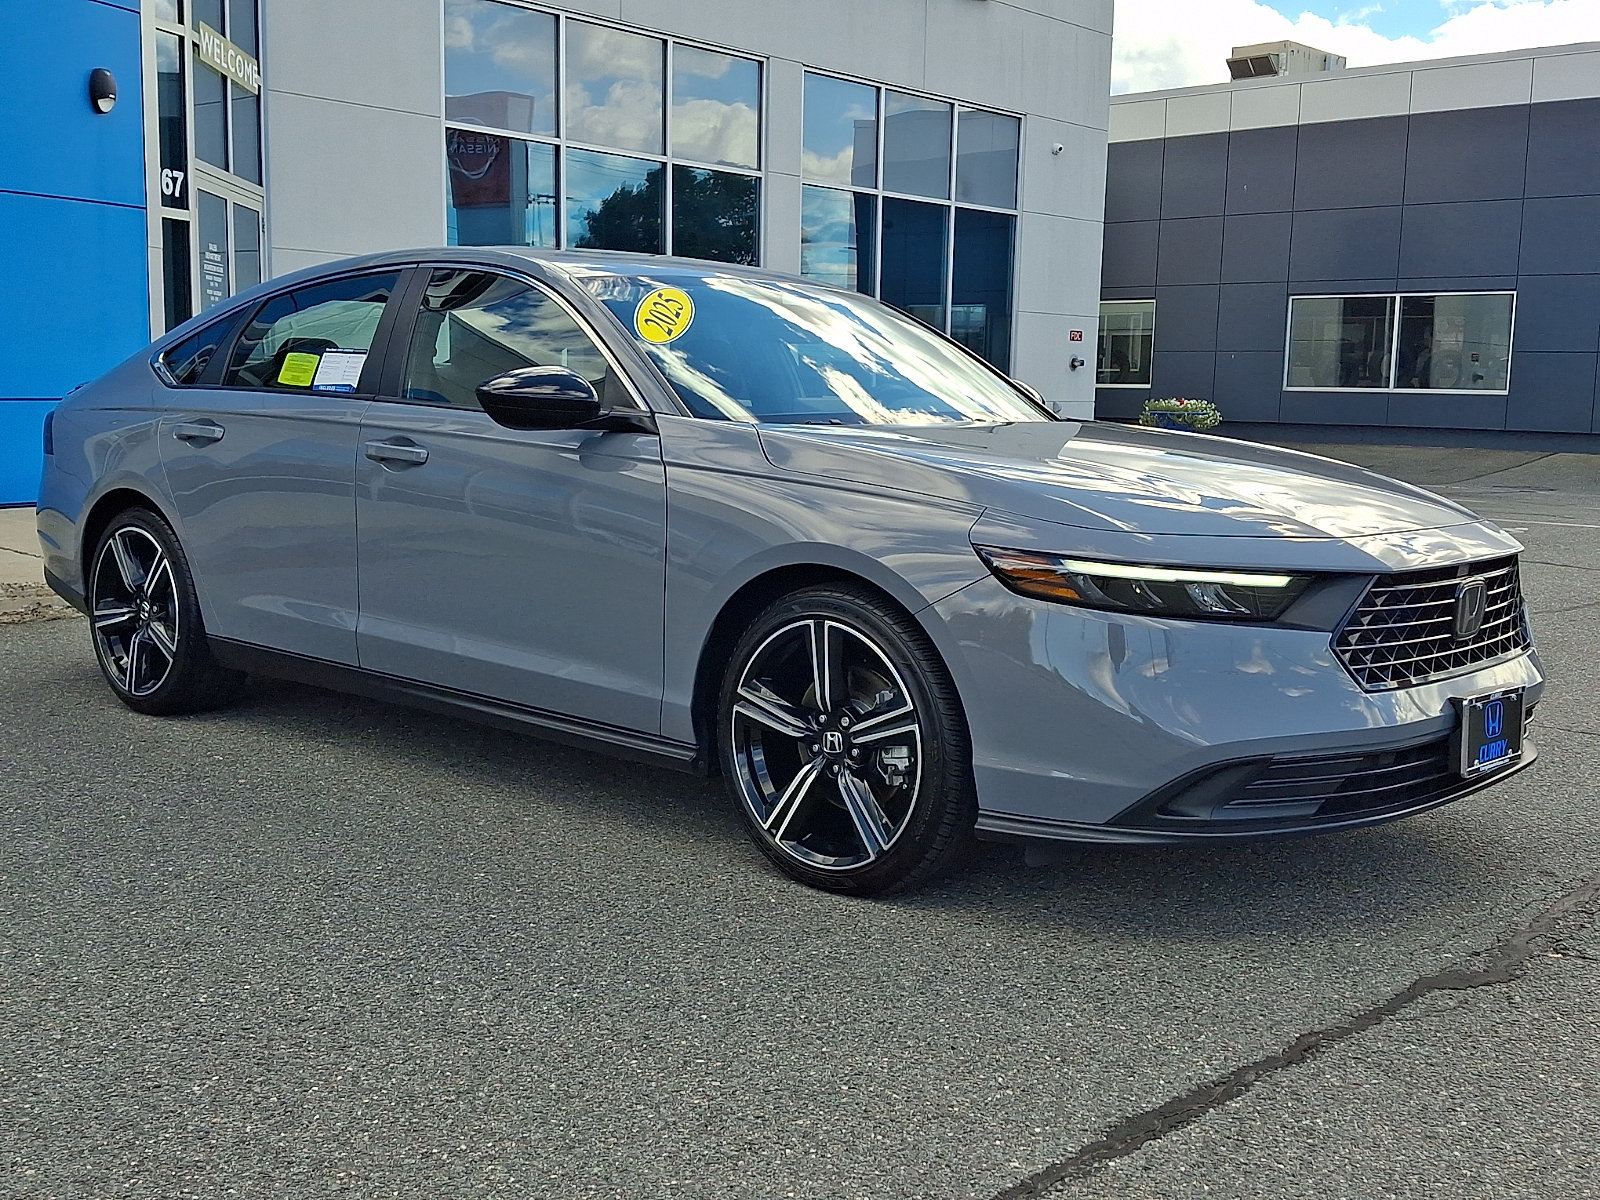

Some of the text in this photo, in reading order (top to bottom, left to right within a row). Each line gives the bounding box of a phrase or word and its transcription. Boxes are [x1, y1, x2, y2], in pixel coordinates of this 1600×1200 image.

[200, 28, 258, 89] WELCOME
[161, 168, 184, 197] 67
[643, 292, 683, 337] 2025
[1071, 331, 1082, 341] FDC
[1479, 739, 1508, 763] CURRY
